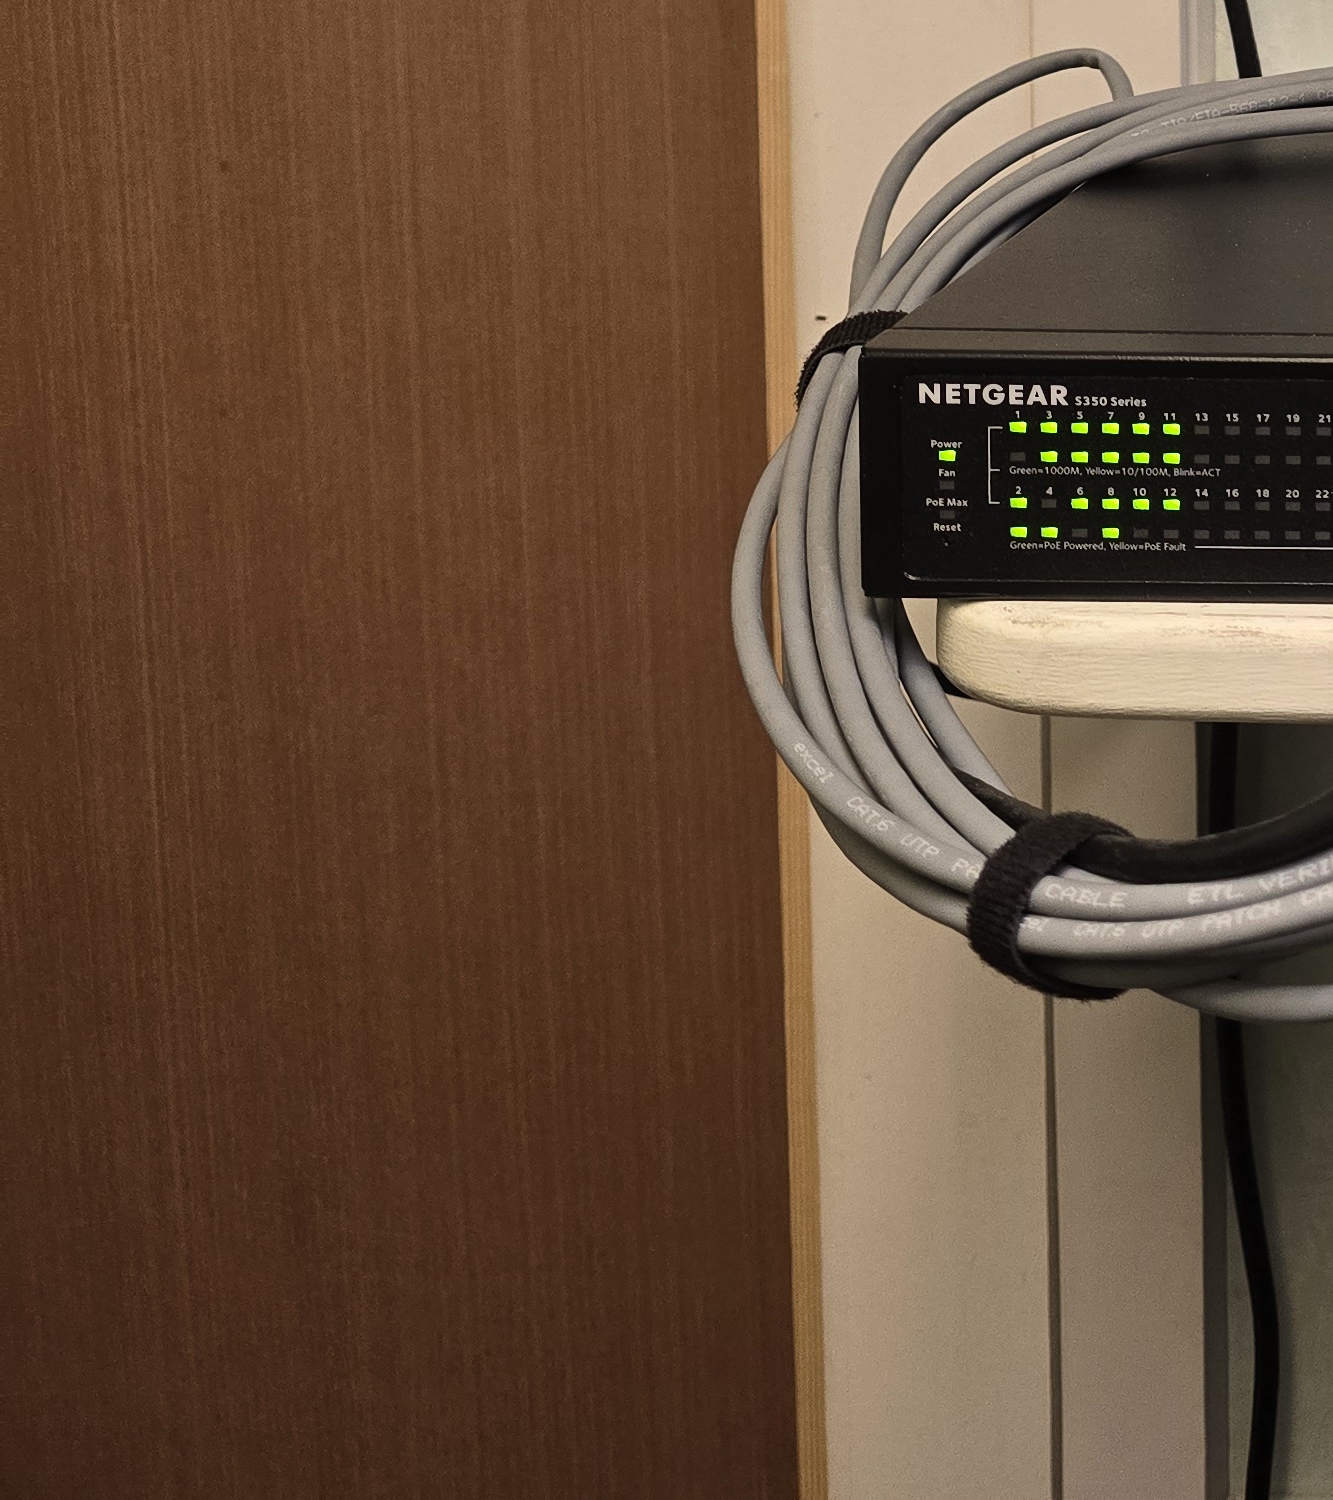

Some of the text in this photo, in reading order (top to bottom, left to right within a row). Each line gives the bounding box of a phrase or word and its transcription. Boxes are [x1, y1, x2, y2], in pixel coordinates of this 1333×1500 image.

[918, 382, 1147, 407] NETGEAR S350 Series
[1015, 410, 1020, 419] 1
[1046, 410, 1053, 420] 3
[1076, 410, 1084, 420] 5
[1107, 411, 1115, 421] 7
[1138, 411, 1146, 421] 9
[1163, 412, 1176, 421] 11
[1195, 412, 1209, 422] 13
[1225, 413, 1239, 423] 15
[1256, 413, 1271, 423] 17
[1286, 413, 1301, 423] 19
[1318, 413, 1331, 424] 21
[930, 439, 963, 449] Power
[938, 468, 956, 478] Fan
[1015, 485, 1023, 496] 2
[1045, 486, 1053, 496] 4
[1076, 486, 1084, 496] 6
[1107, 486, 1115, 497] 8
[1132, 487, 1147, 497] 10
[1163, 487, 1177, 497] 12
[1194, 488, 1209, 498] 14
[1225, 488, 1240, 498] 16
[1255, 488, 1270, 498] 18
[1285, 488, 1300, 499] 20
[1315, 489, 1330, 499] 22
[925, 497, 969, 507] PoE Max
[933, 522, 962, 532] Reset
[1009, 540, 1061, 551] Green=PoE
[1108, 541, 1162, 551] Yellow=PoE
[1163, 542, 1187, 552] Fault
[793, 742, 834, 784] excel
[900, 833, 940, 860] UTP
[1044, 883, 1129, 908] CABLE
[1186, 883, 1243, 905] ETL
[1141, 919, 1187, 938] UTP
[1200, 900, 1281, 933] PATCH
